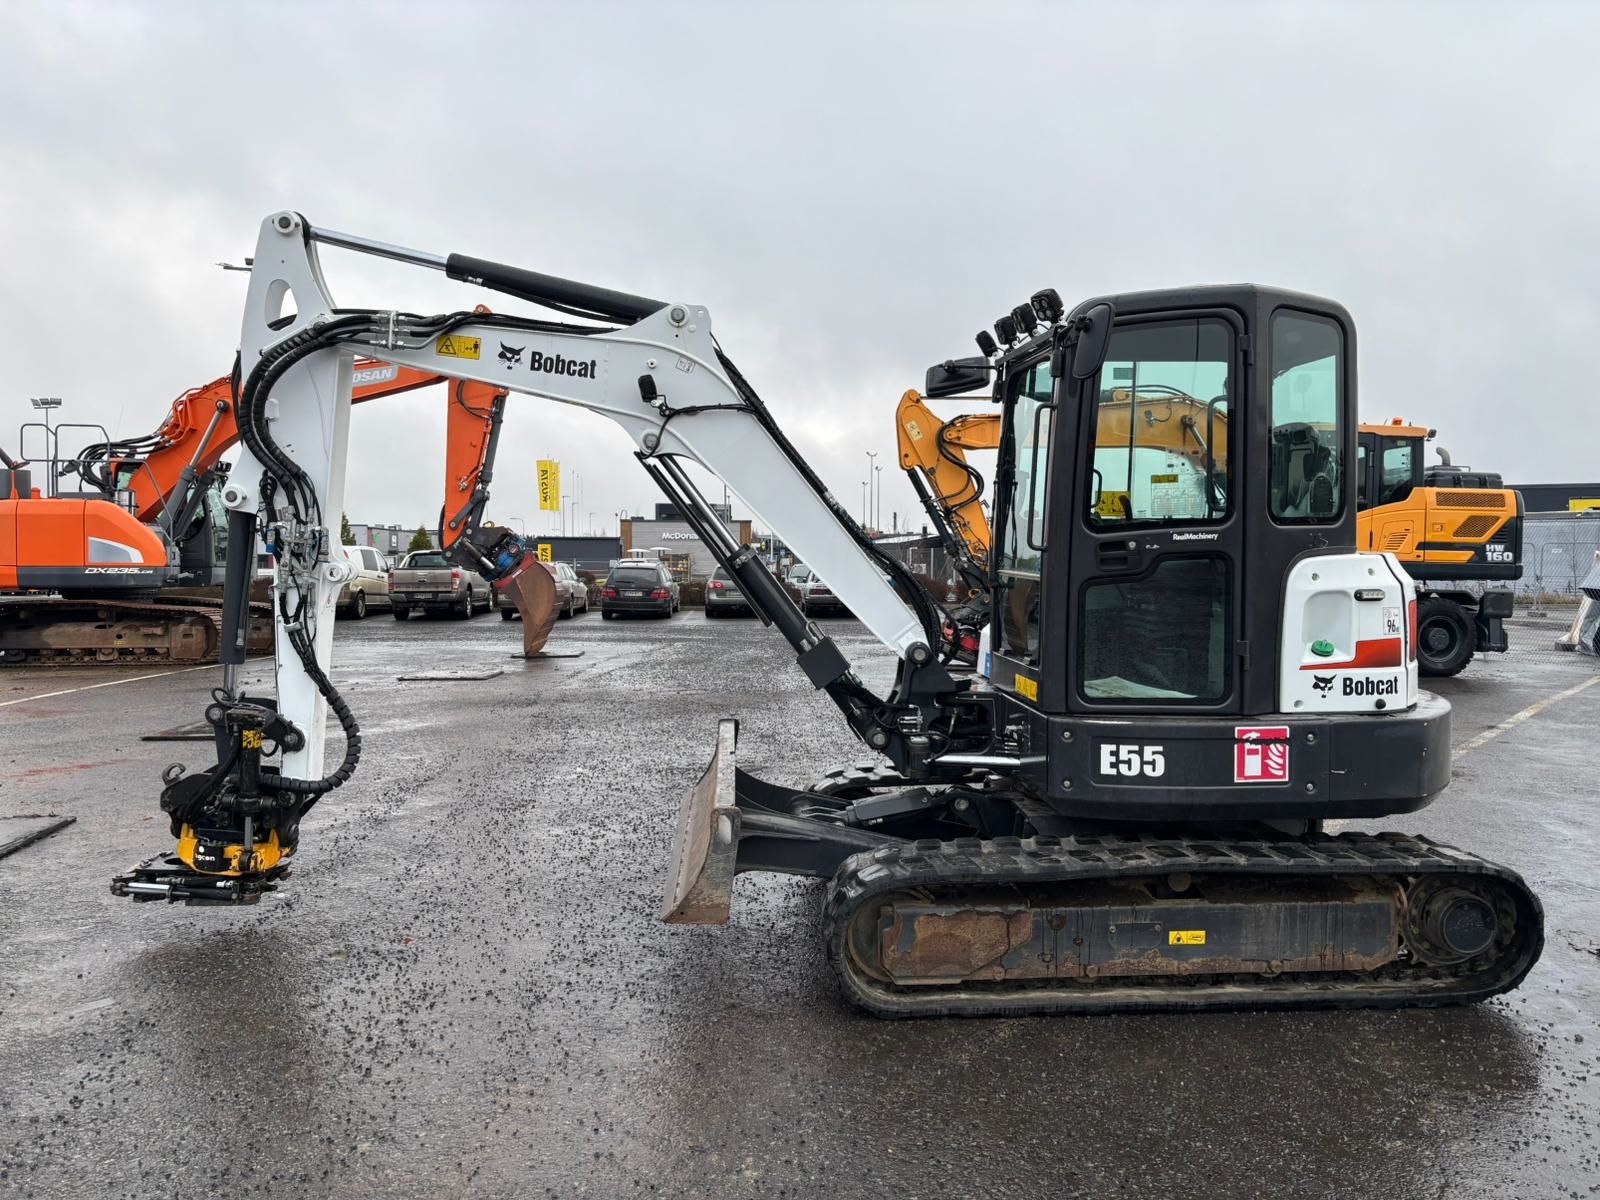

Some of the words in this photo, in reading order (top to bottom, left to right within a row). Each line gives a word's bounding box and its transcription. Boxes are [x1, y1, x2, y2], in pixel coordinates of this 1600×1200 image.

[530, 351, 596, 379] Bobcat
[1485, 544, 1505, 552] HW
[1485, 551, 1513, 561] 160
[1342, 676, 1398, 696] Bobcat
[1100, 744, 1165, 777] E55
